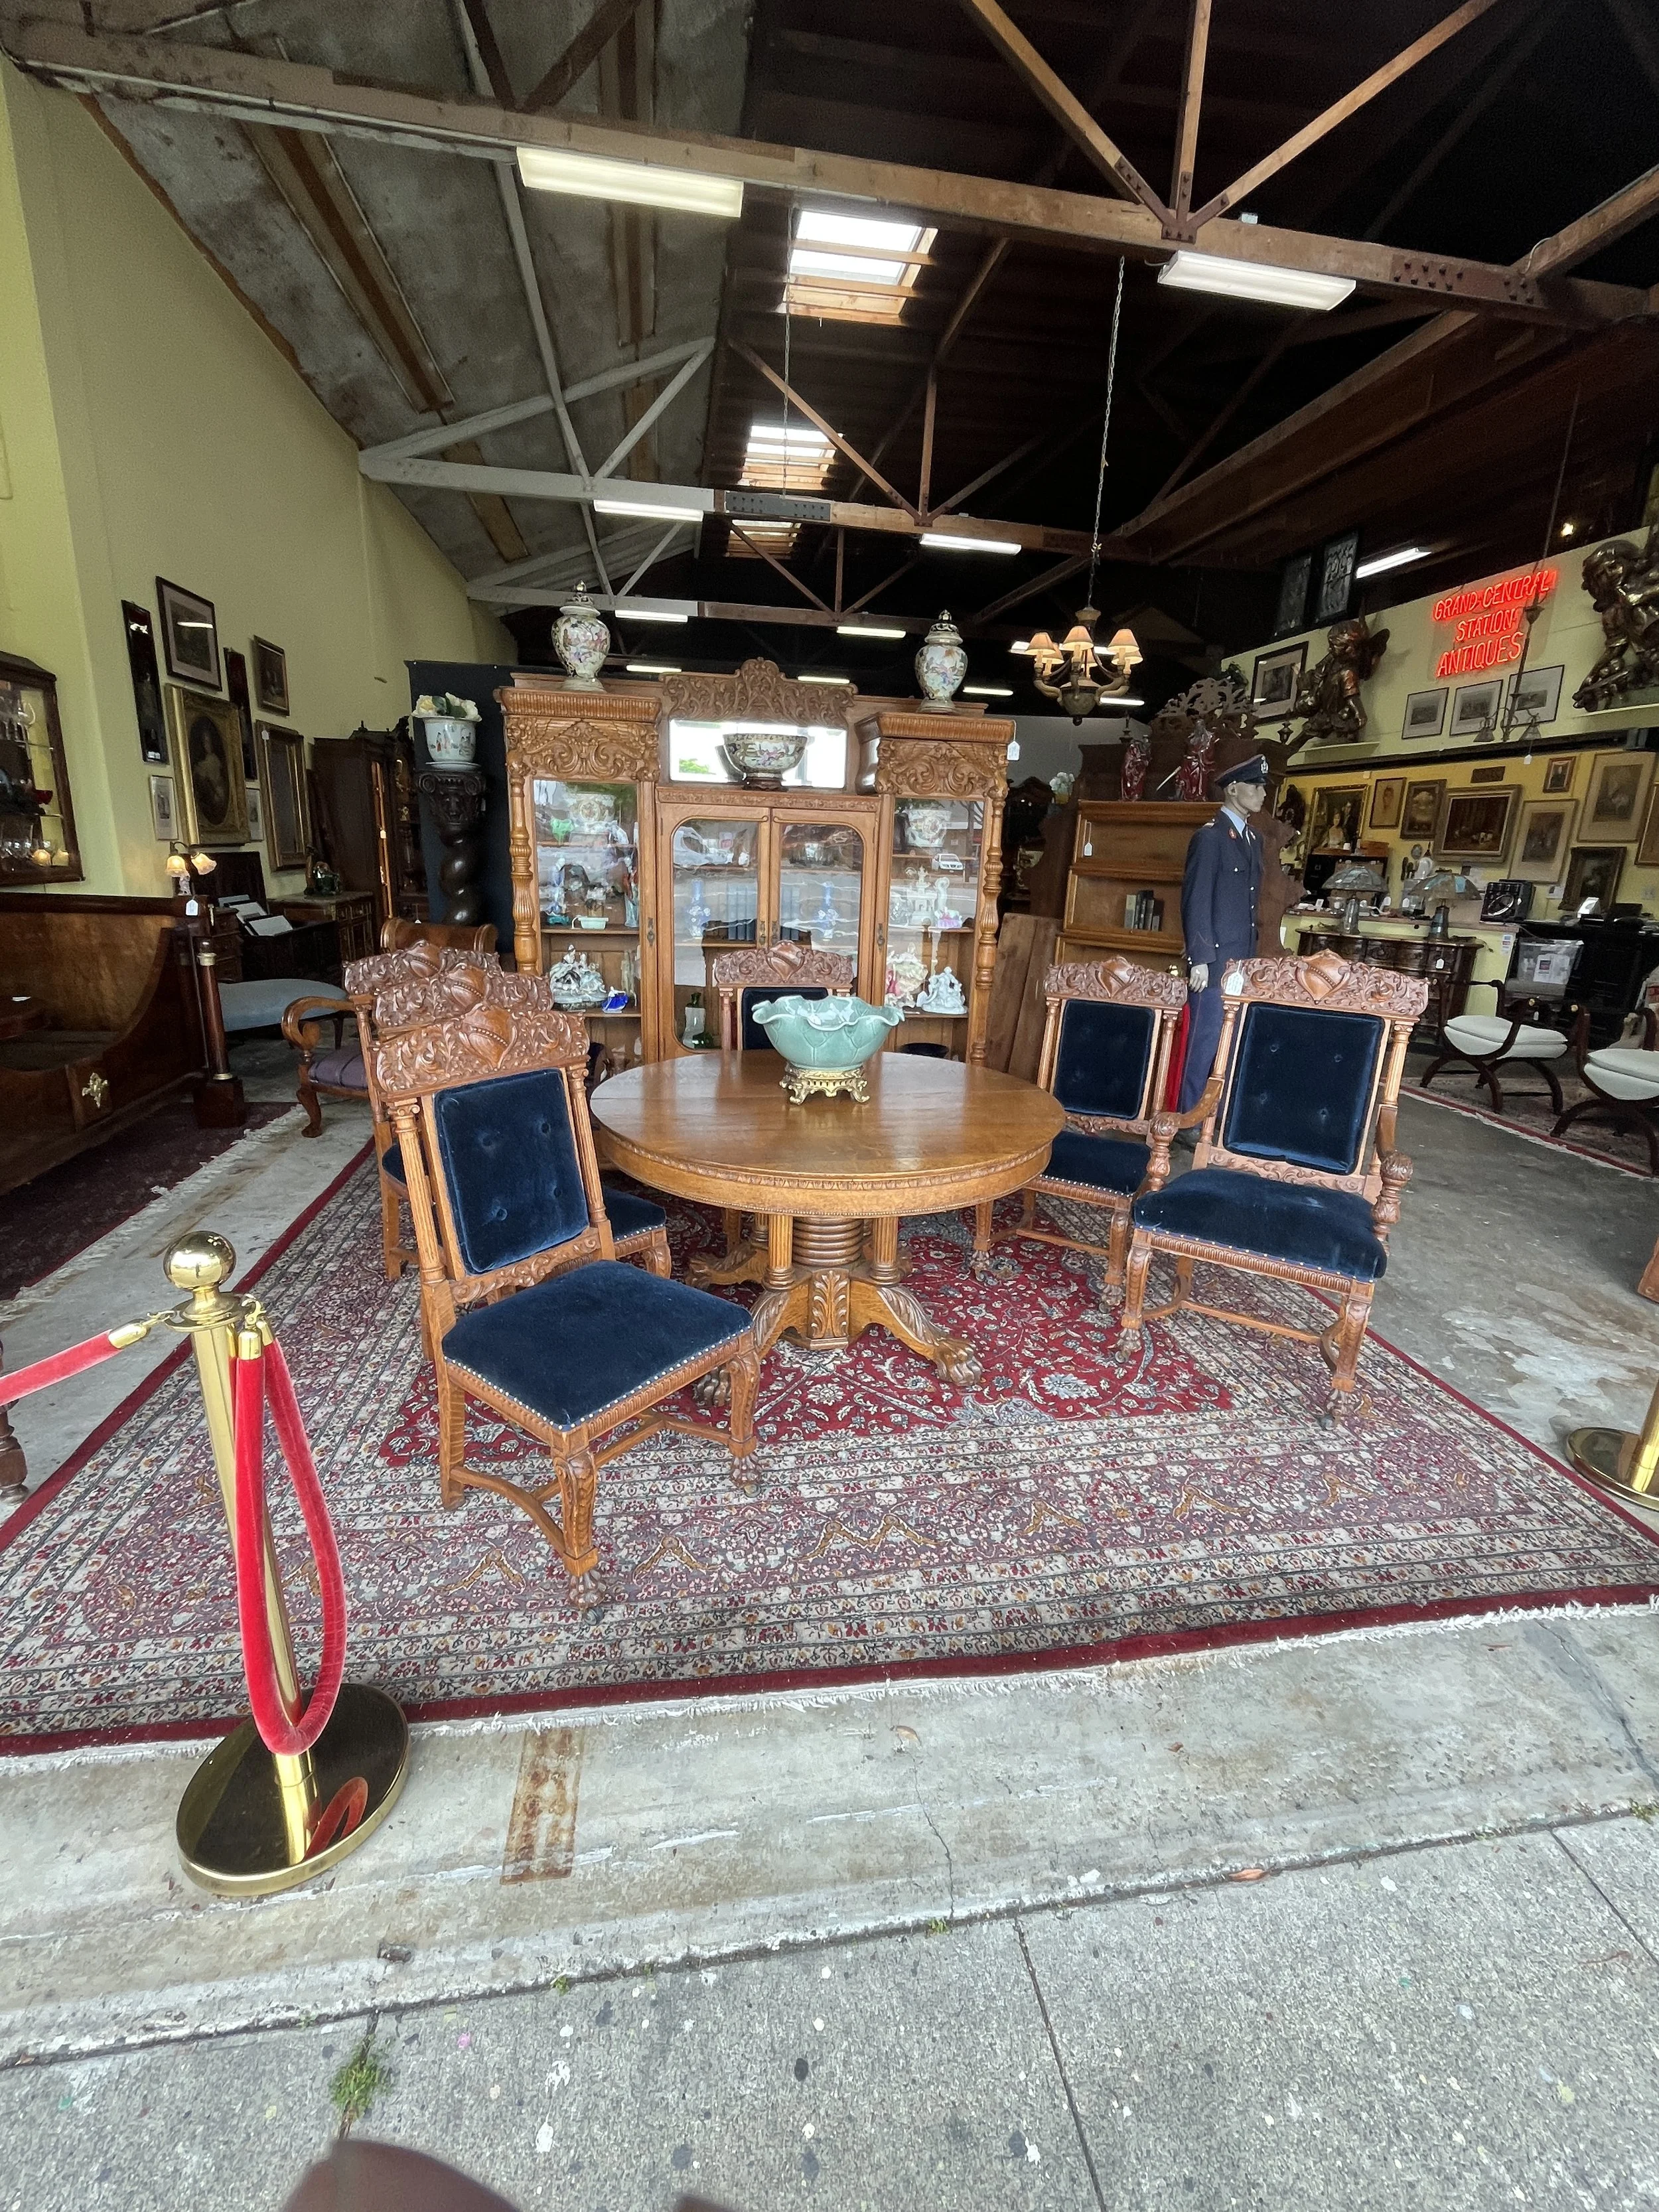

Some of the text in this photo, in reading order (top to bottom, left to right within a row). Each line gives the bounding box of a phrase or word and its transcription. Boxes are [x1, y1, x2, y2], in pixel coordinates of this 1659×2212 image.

[1434, 570, 1550, 621] GRAND CENTRAL
[1456, 609, 1515, 642] STATION
[1437, 631, 1524, 677] ANTIQUES
